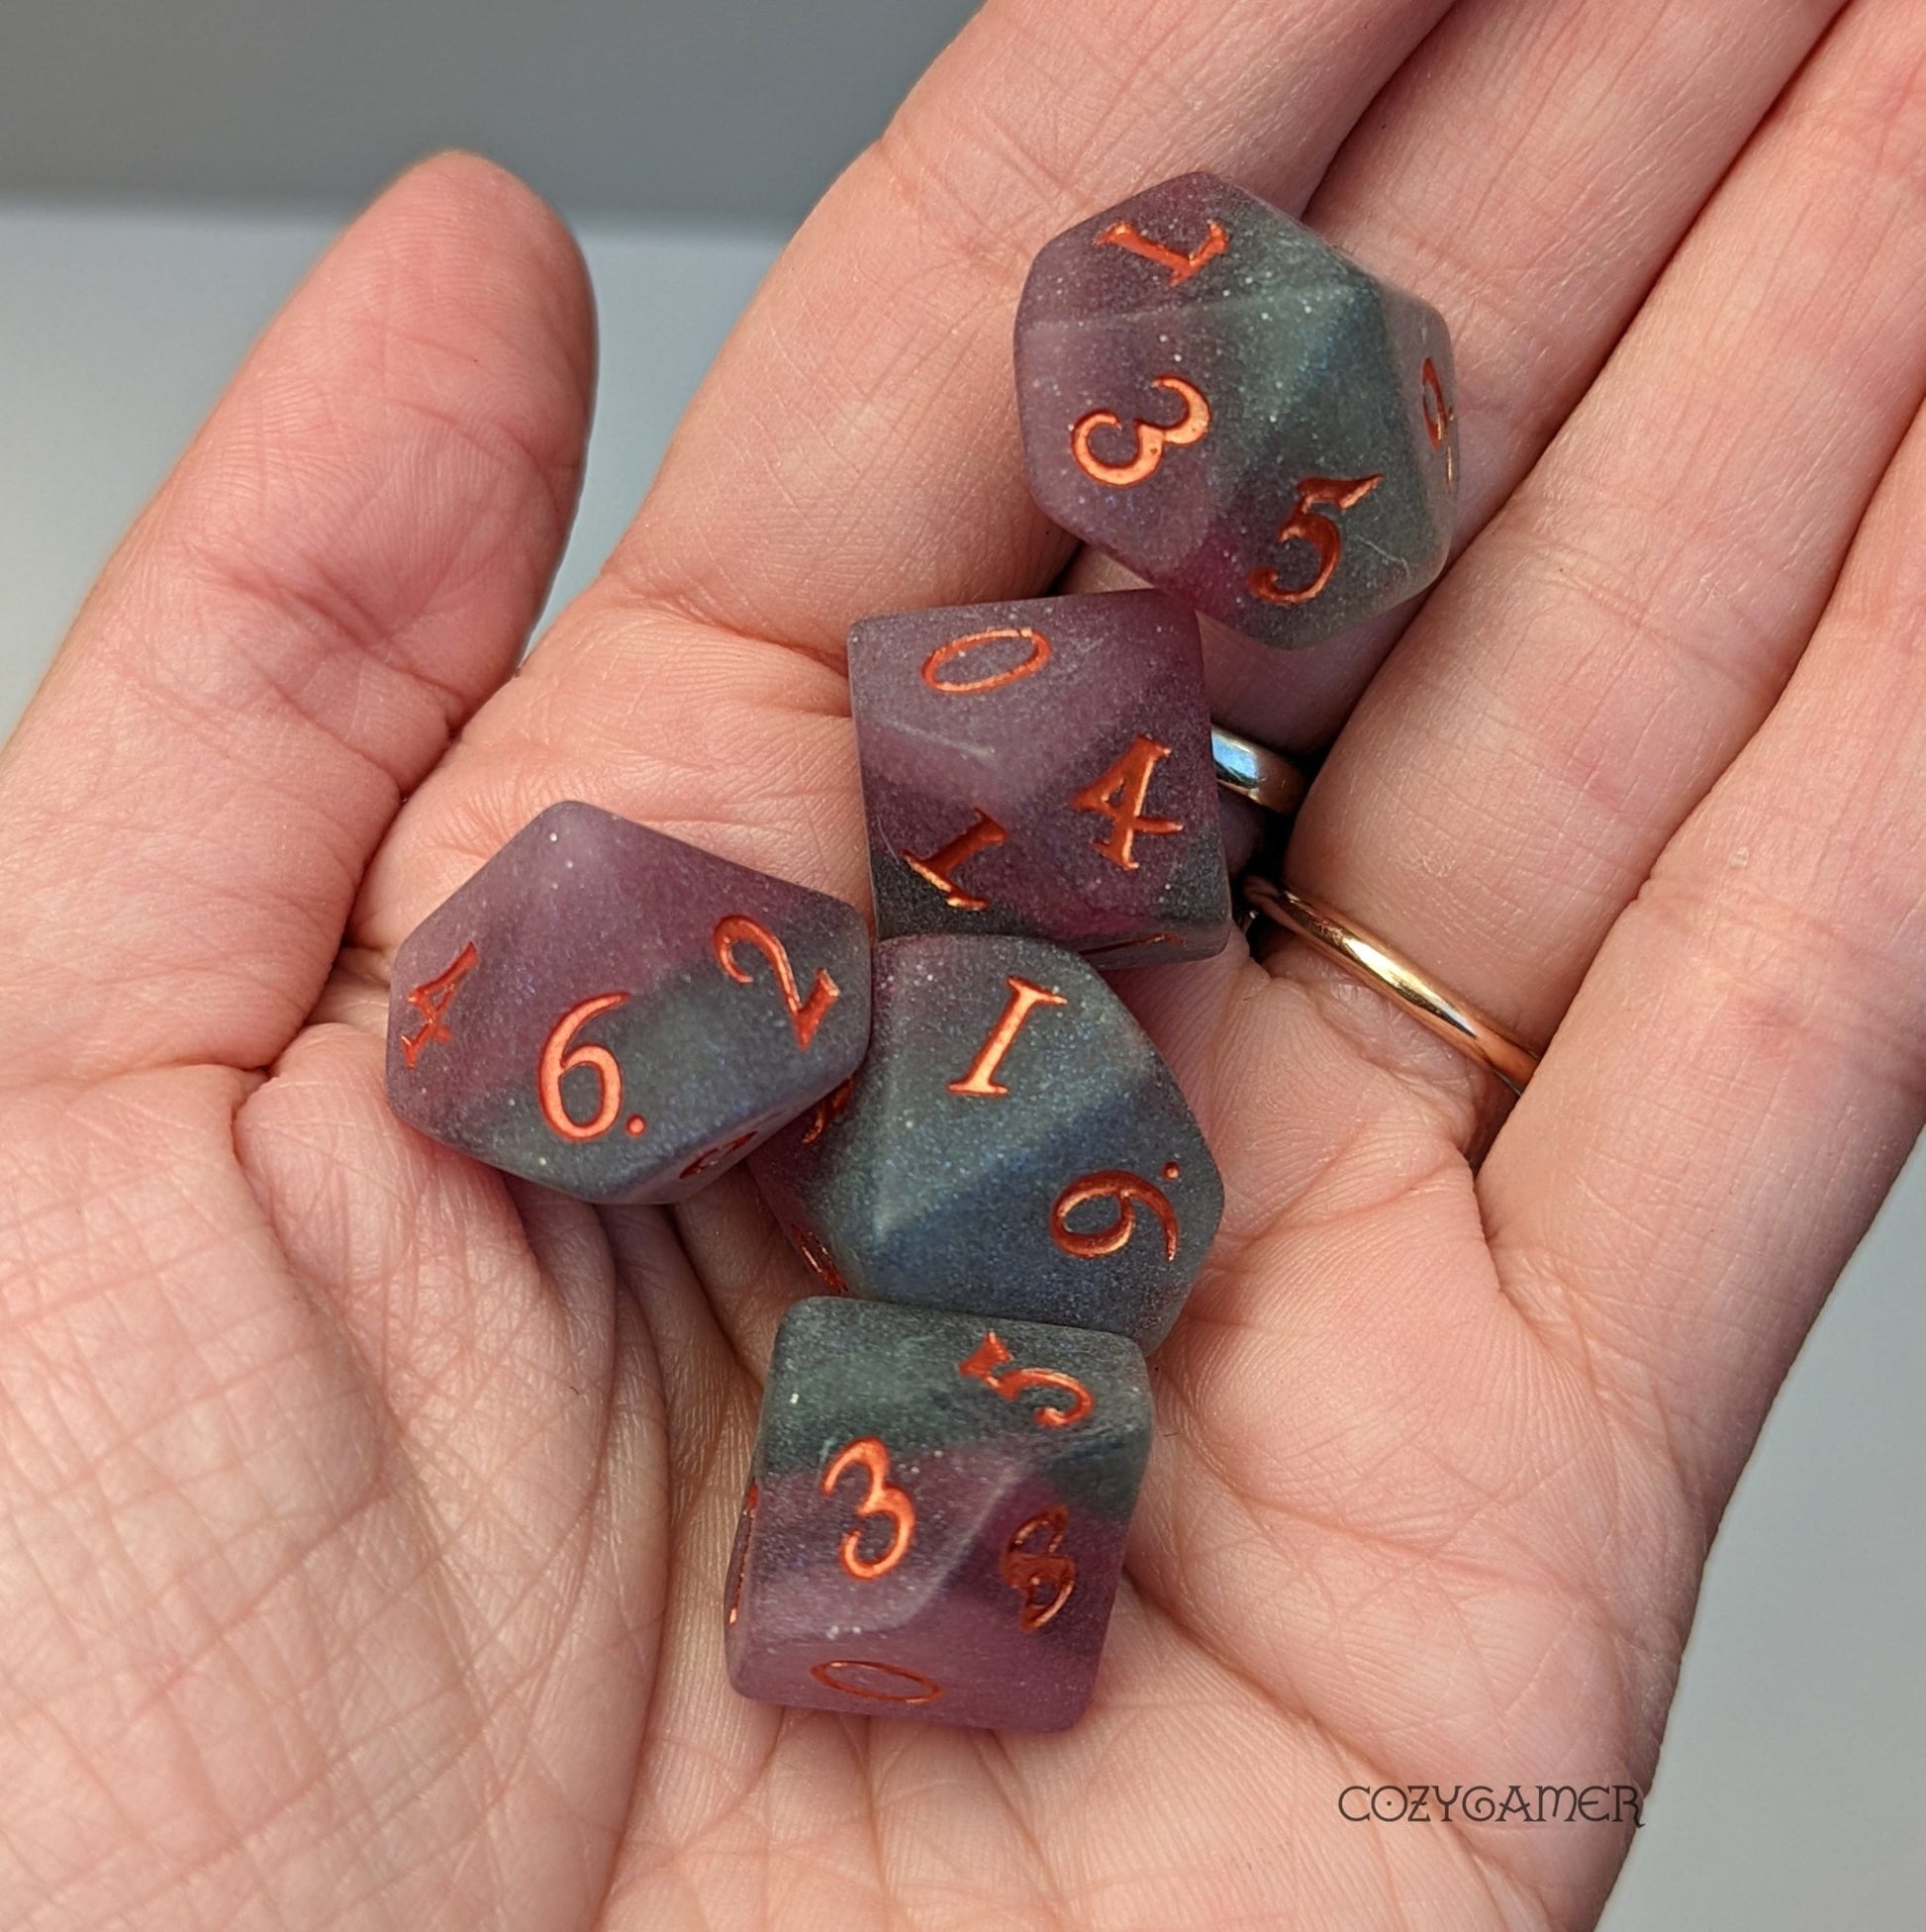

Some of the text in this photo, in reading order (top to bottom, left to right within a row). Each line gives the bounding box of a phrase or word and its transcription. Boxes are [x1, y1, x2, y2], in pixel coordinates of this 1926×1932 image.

[1095, 222, 1229, 286] 1
[1071, 374, 1211, 489] 3
[1247, 473, 1384, 607] 5
[921, 628, 1052, 694] 0
[902, 807, 1009, 911] 1
[1071, 733, 1184, 872] 4
[400, 940, 480, 1070] 4
[712, 915, 841, 1052] 2
[945, 975, 1069, 1097] 1
[958, 1332, 1095, 1427] 5
[822, 1435, 915, 1580] 3
[1003, 1504, 1076, 1630] 8
[811, 1660, 943, 1704] 0
